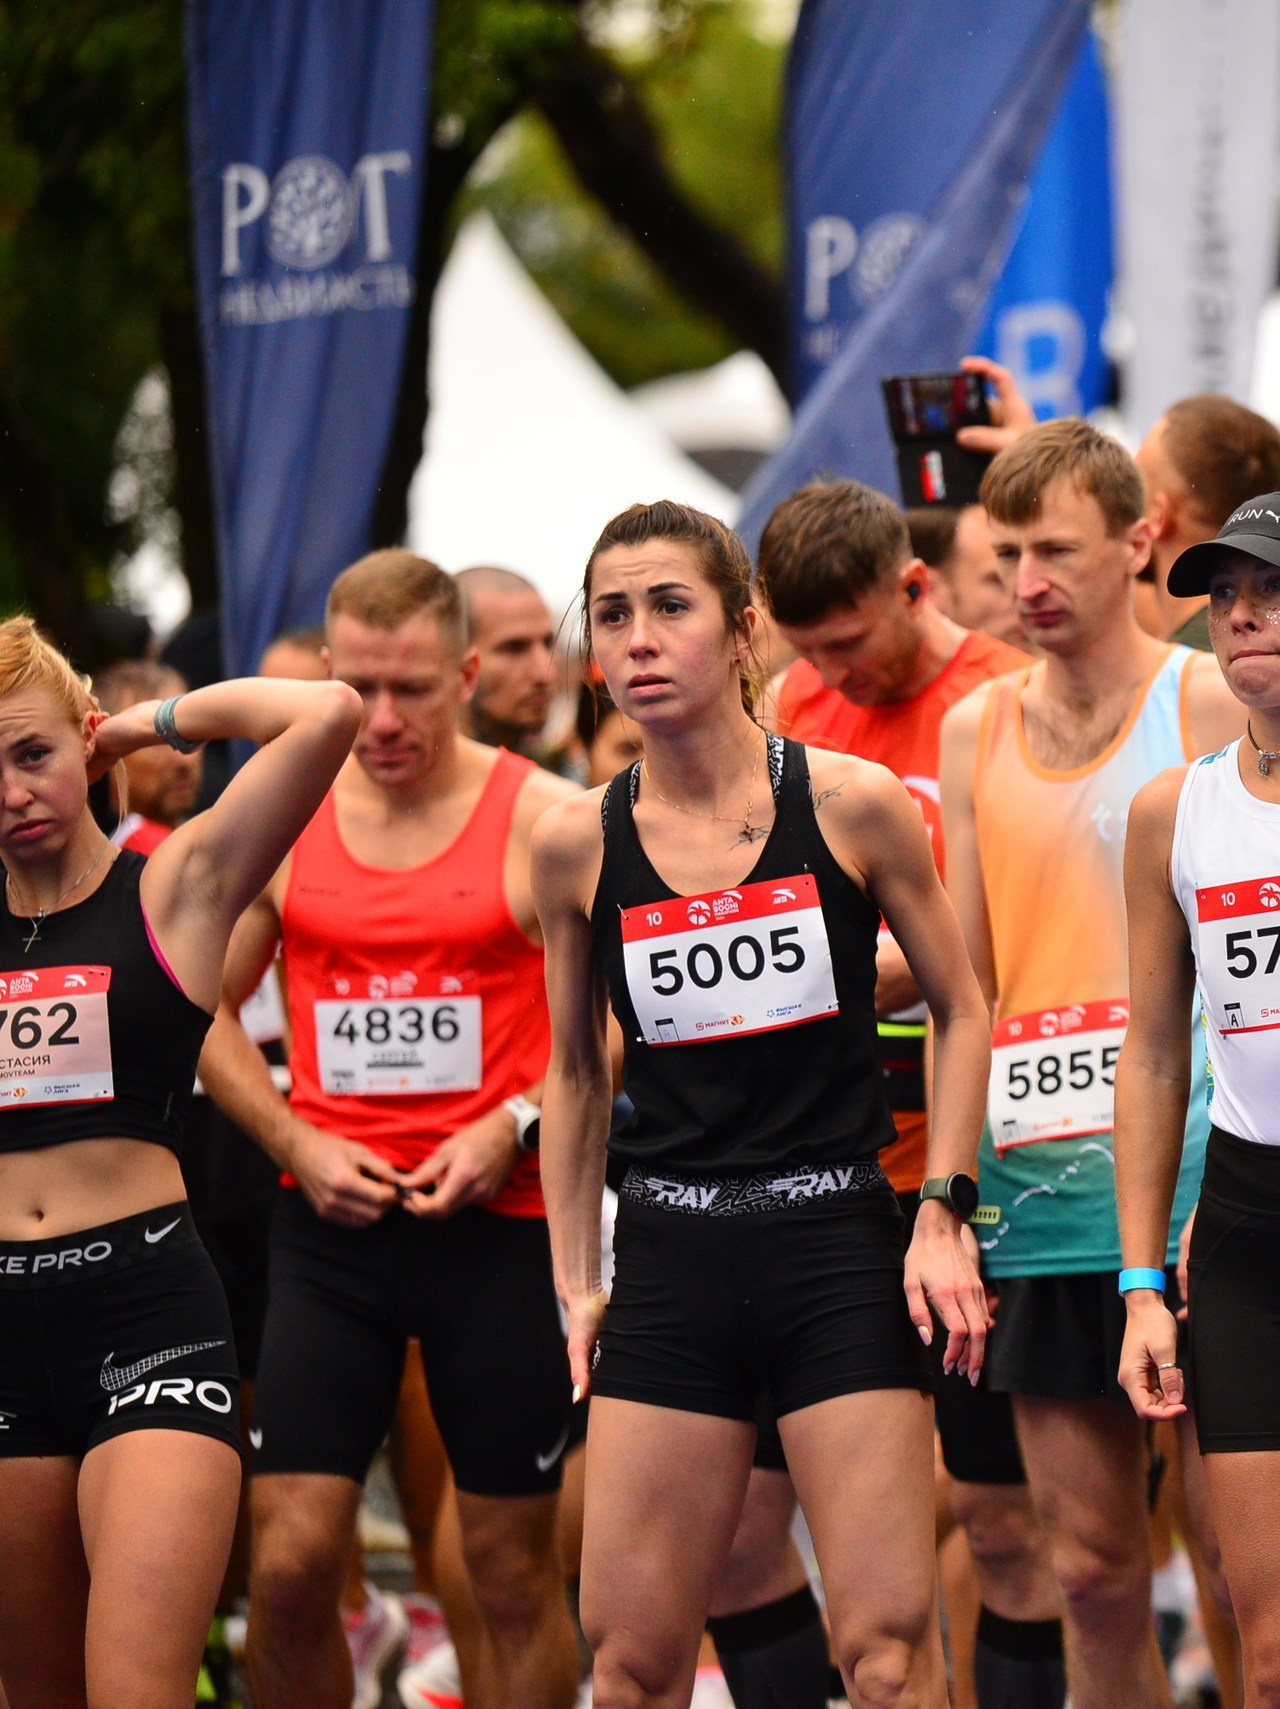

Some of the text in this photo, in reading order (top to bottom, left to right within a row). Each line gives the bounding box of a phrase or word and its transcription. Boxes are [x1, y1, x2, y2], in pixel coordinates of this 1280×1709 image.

[1227, 508, 1264, 526] RUN
[712, 896, 735, 907] ANTA
[712, 901, 739, 913] SOCHI
[773, 895, 788, 905] ANTA
[1220, 891, 1236, 907] 10
[645, 911, 663, 927] 10
[649, 925, 806, 996] 5005
[0, 1002, 80, 1050] 62
[333, 1005, 460, 1045] 4836
[705, 1019, 730, 1029] МАГНИТ
[1008, 1021, 1023, 1037] 10
[1008, 1046, 1122, 1101] 5855
[32, 1241, 113, 1274] PRO
[107, 1377, 233, 1416] PRO
